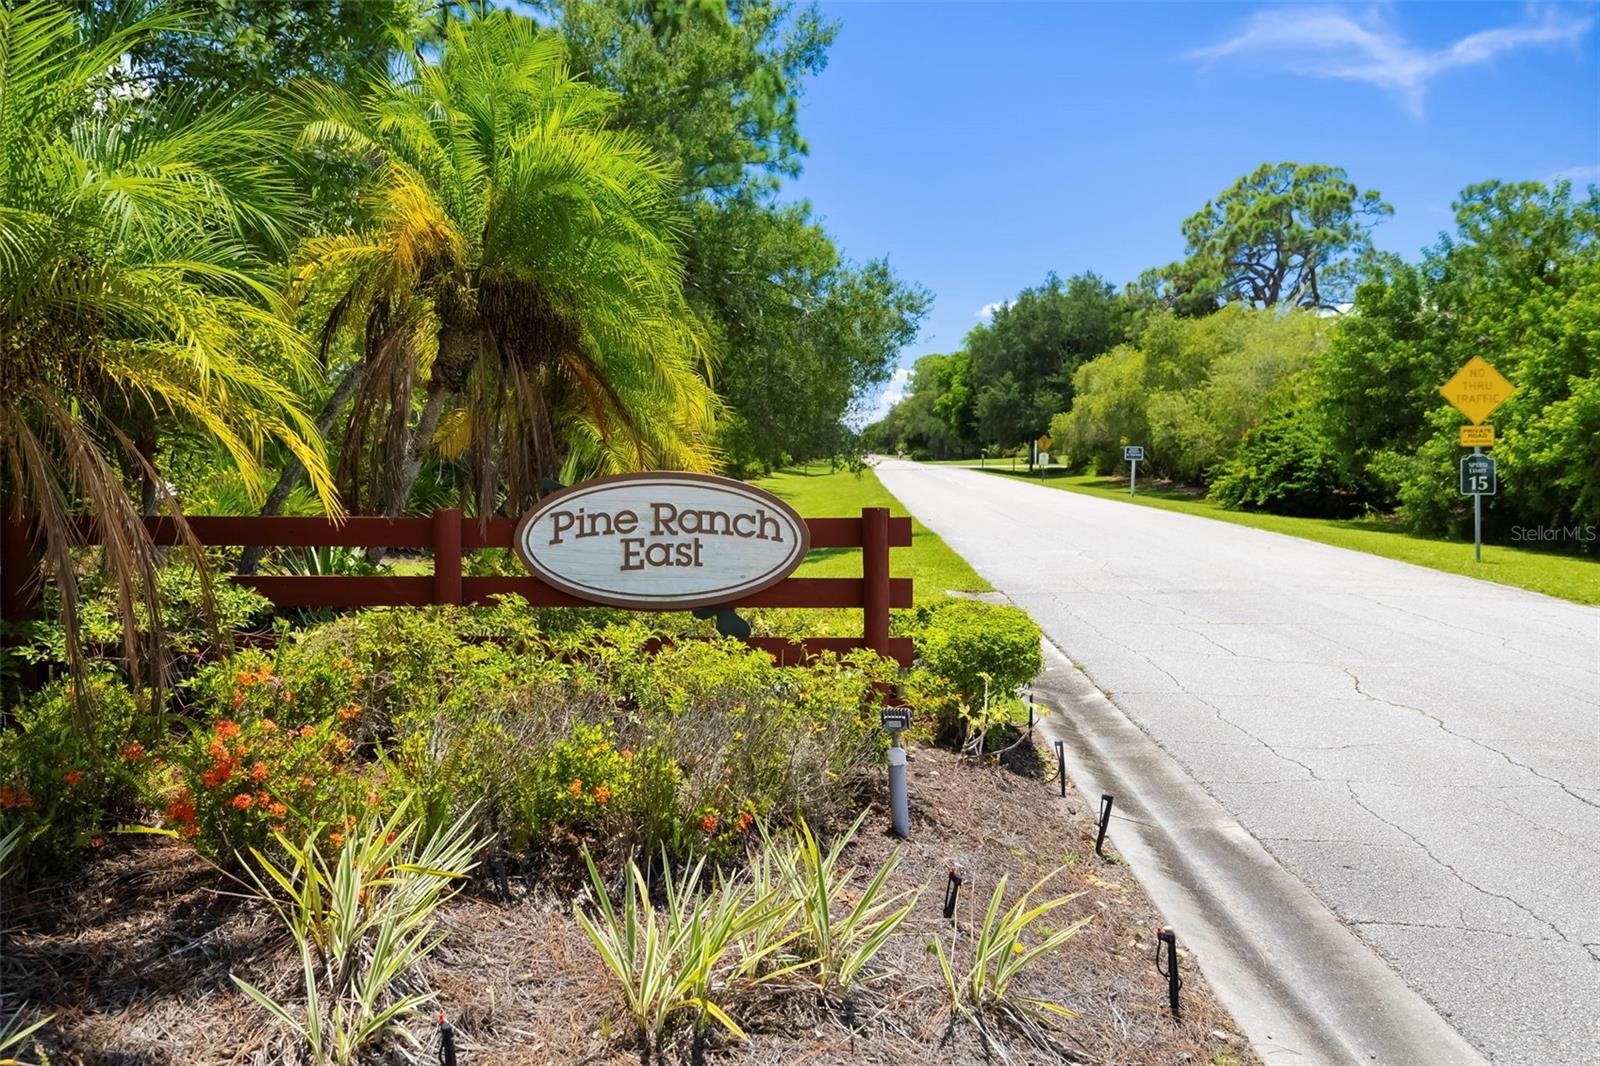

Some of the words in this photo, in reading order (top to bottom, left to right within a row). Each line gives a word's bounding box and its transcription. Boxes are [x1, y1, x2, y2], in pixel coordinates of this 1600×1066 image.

[1469, 368, 1485, 378] NO
[1463, 381, 1493, 390] THRU
[1456, 394, 1500, 403] TRAFFIC
[1468, 475, 1488, 491] 15
[548, 507, 639, 546] Pine
[649, 502, 784, 543] Ranch
[619, 537, 704, 571] East
